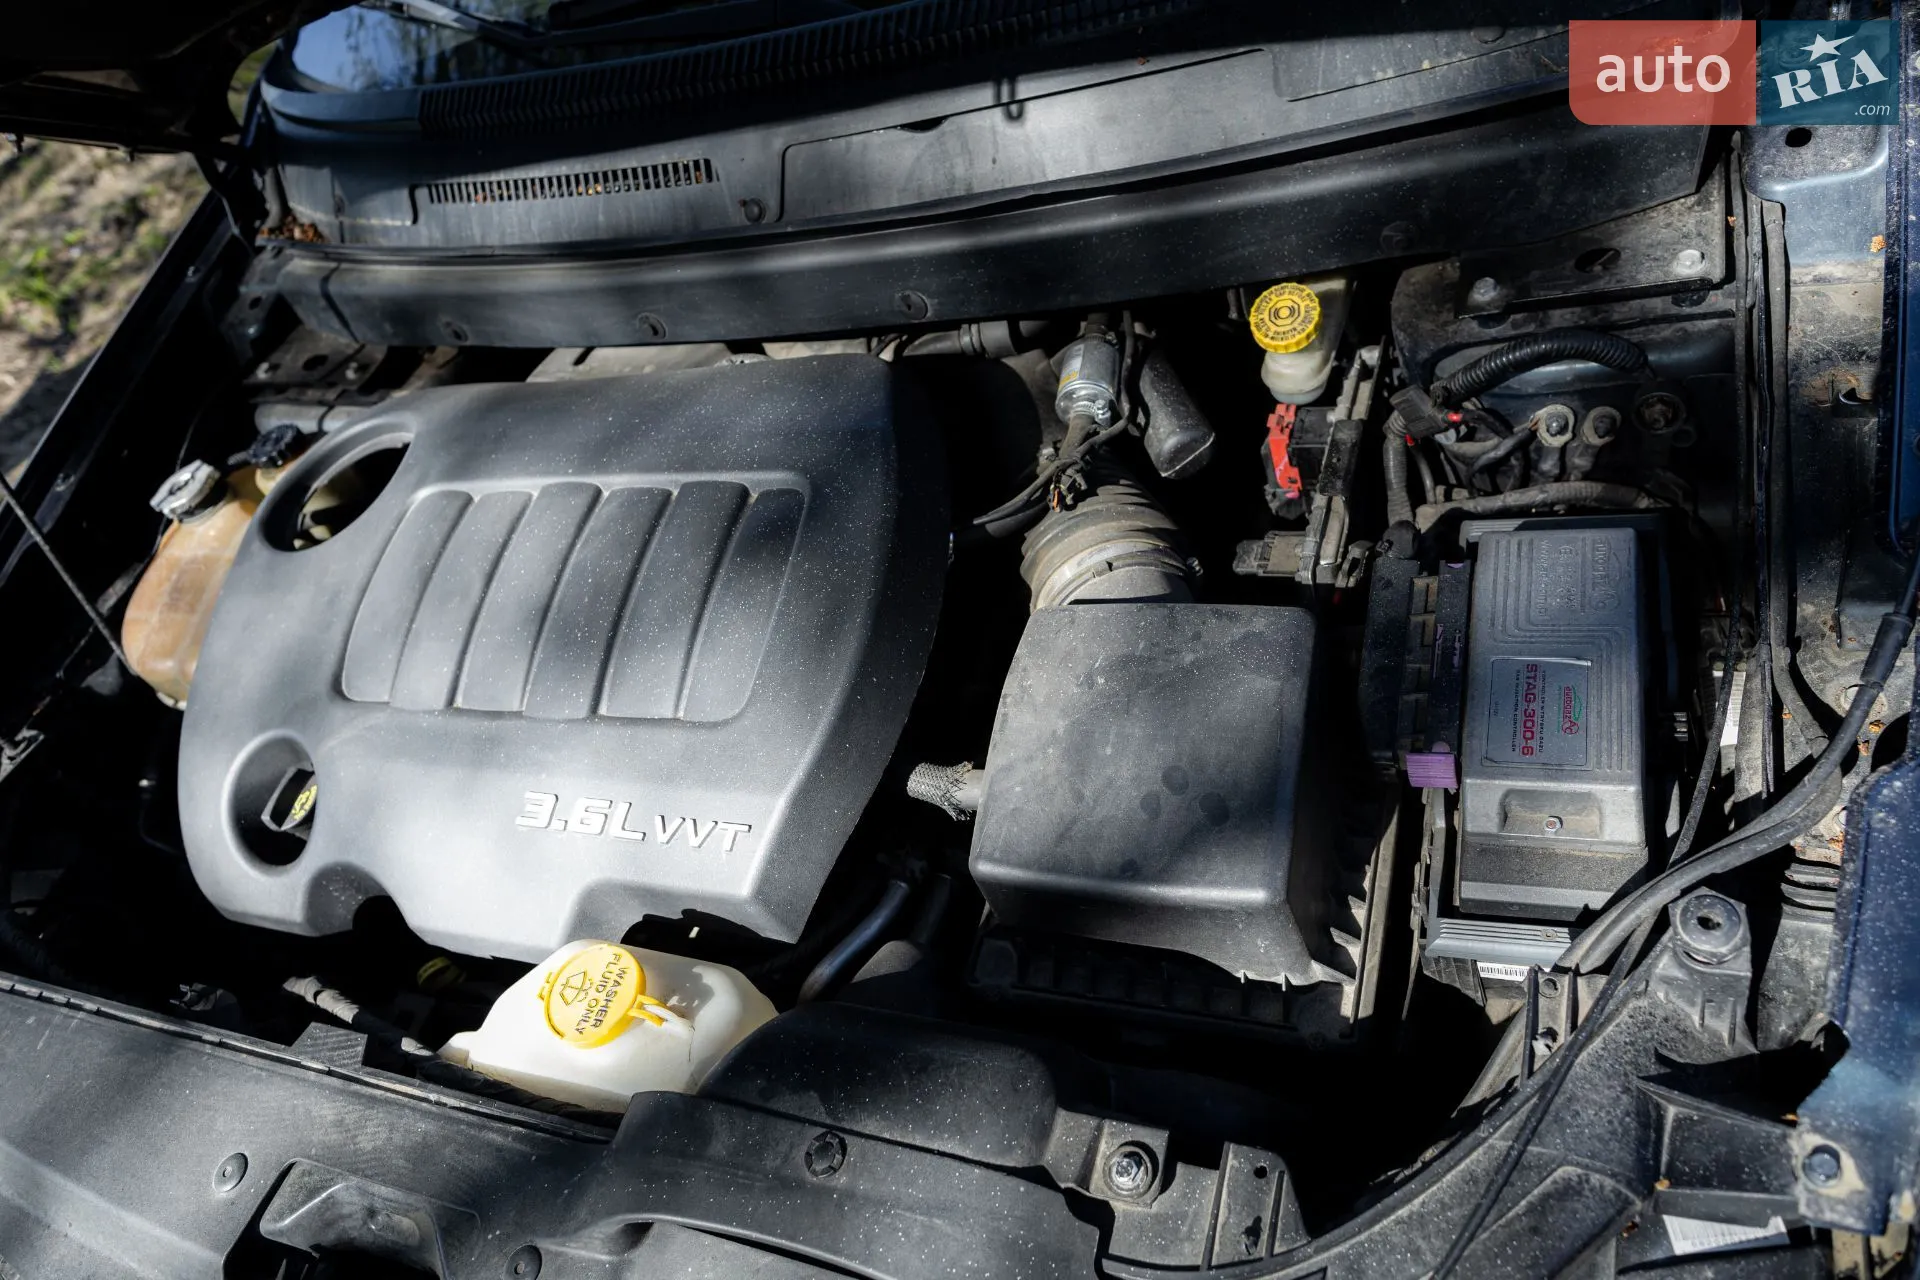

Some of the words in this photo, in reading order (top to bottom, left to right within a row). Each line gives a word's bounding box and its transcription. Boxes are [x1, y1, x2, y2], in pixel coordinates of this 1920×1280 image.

[1521, 663, 1538, 756] STAG-300-6
[515, 791, 647, 842] 3.6L
[654, 814, 752, 853] VVT
[590, 966, 630, 1029] WASHER
[593, 953, 622, 994] FLUID
[575, 997, 602, 1037] ONLY
